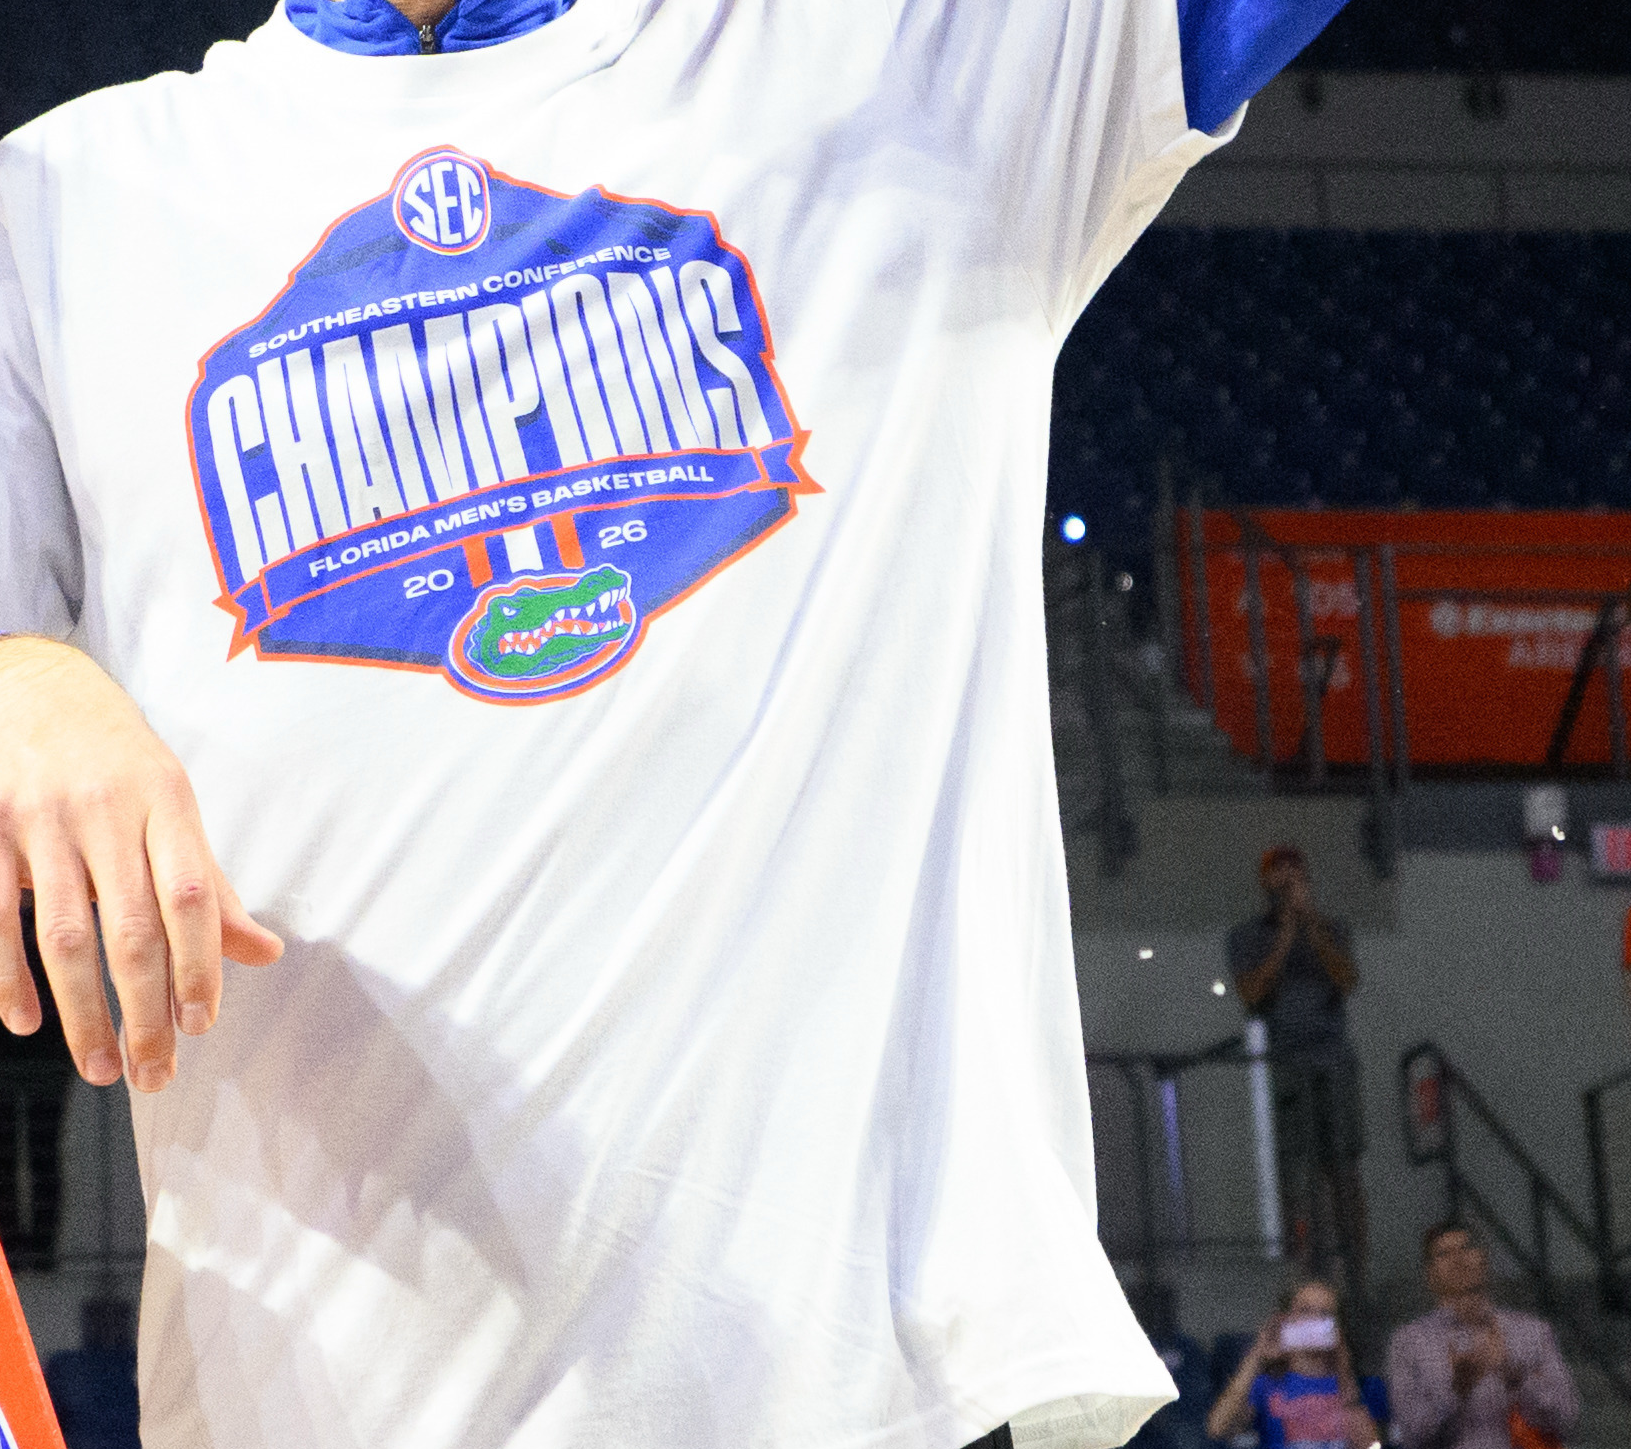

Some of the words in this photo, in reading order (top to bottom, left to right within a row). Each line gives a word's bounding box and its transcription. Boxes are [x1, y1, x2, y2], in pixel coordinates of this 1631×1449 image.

[401, 156, 484, 247] SEC
[247, 278, 480, 361] SOUTHEASTERN
[482, 245, 673, 293] CONFERENCE
[207, 258, 773, 583] CHAMPIONS
[307, 524, 431, 579] FLORIDA
[433, 493, 528, 539] MEN'S
[530, 464, 715, 510] BASKETBALL
[598, 518, 649, 551] 26
[403, 568, 456, 600] 20
